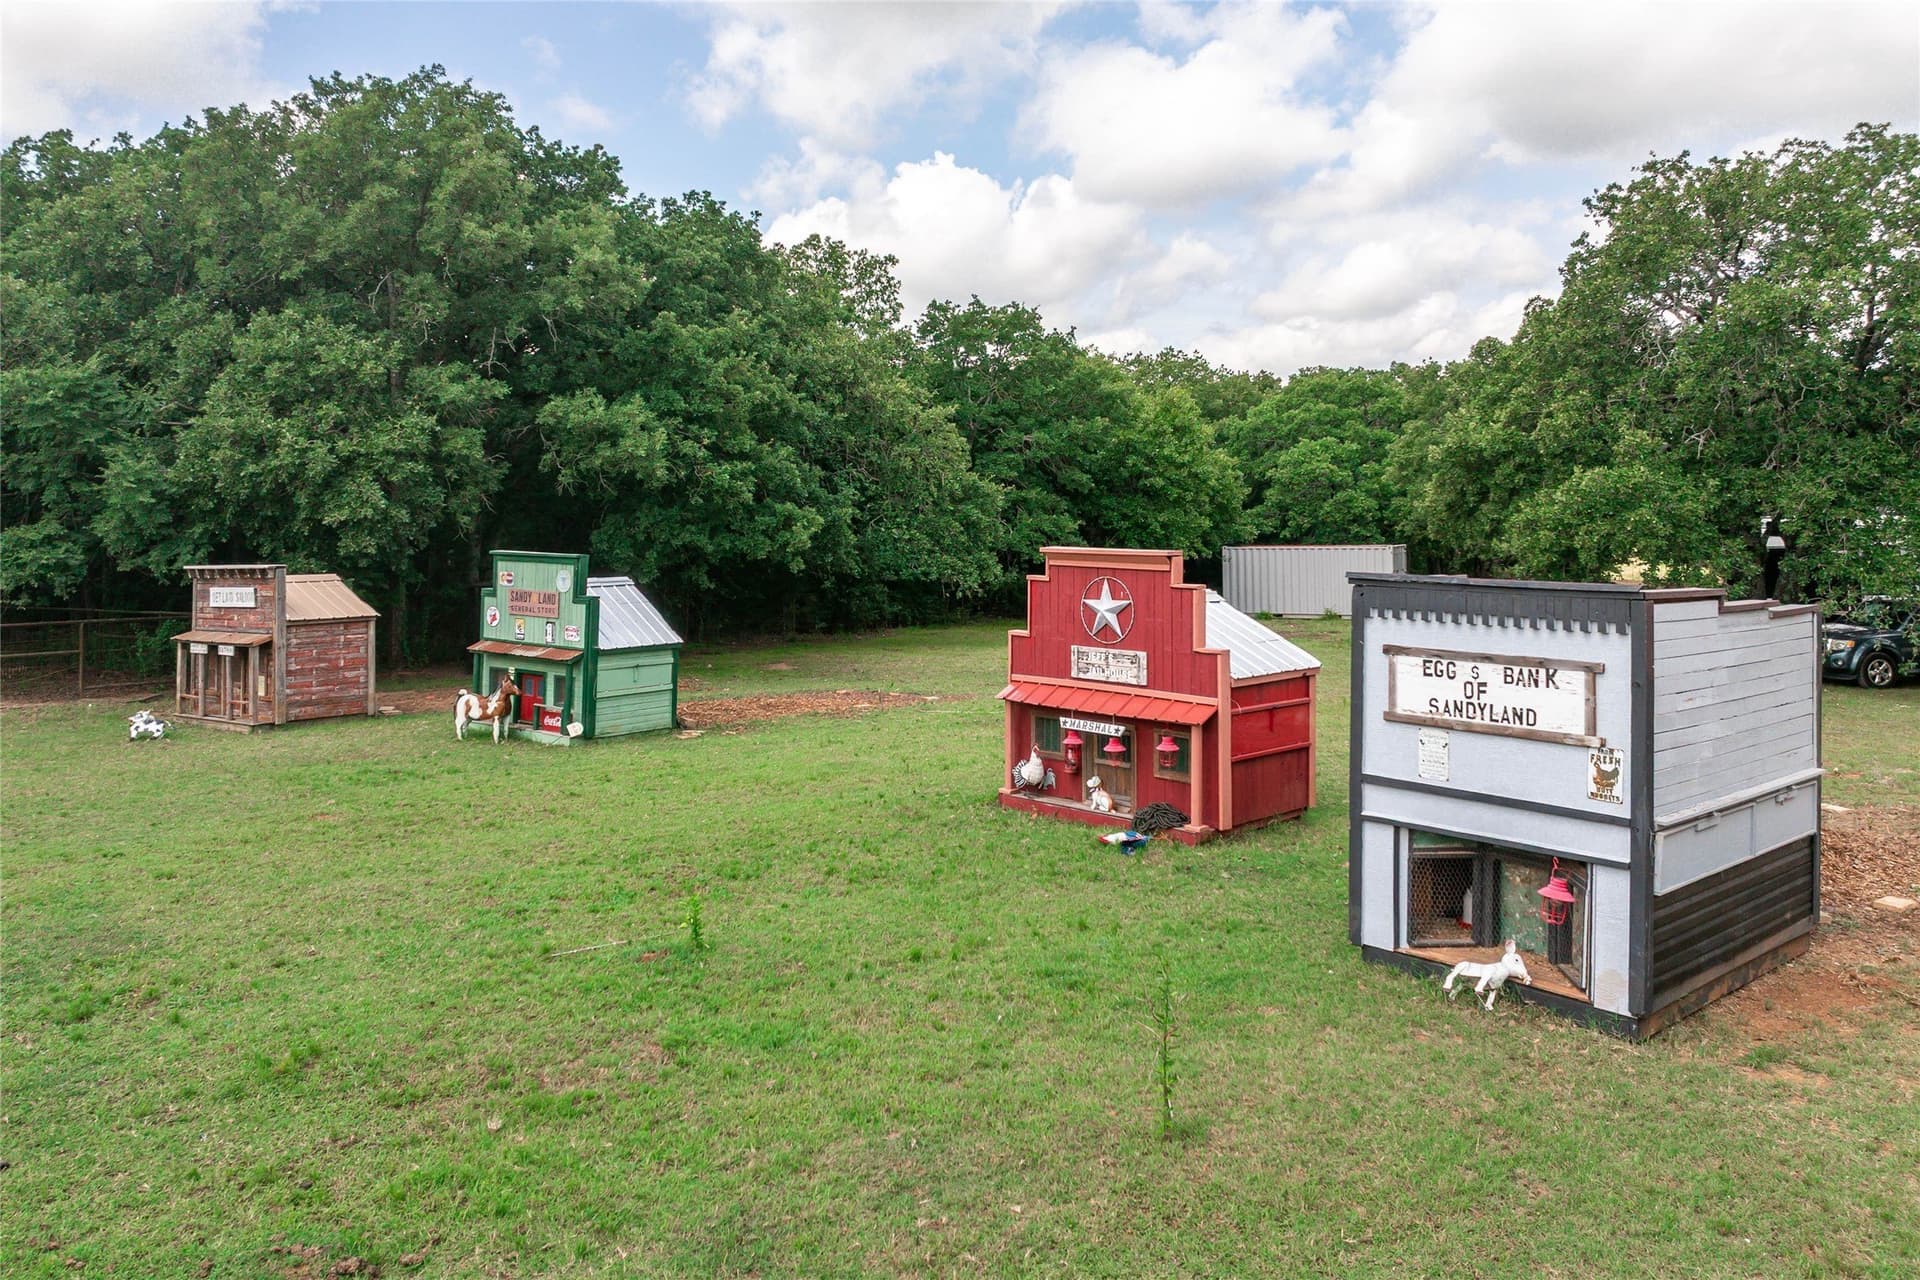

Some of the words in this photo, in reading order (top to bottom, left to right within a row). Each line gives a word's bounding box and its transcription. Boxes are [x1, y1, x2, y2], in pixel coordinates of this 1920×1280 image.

[510, 590, 532, 603] SANDY
[538, 592, 556, 605] LAND
[510, 605, 536, 613] GENERAL
[1422, 659, 1457, 680] EGG
[1503, 667, 1561, 689] BANK
[1463, 681, 1488, 700] OF
[1429, 698, 1537, 727] SANDYLAND
[1069, 720, 1114, 734] MARSHAL
[1590, 753, 1621, 766] FRESH
